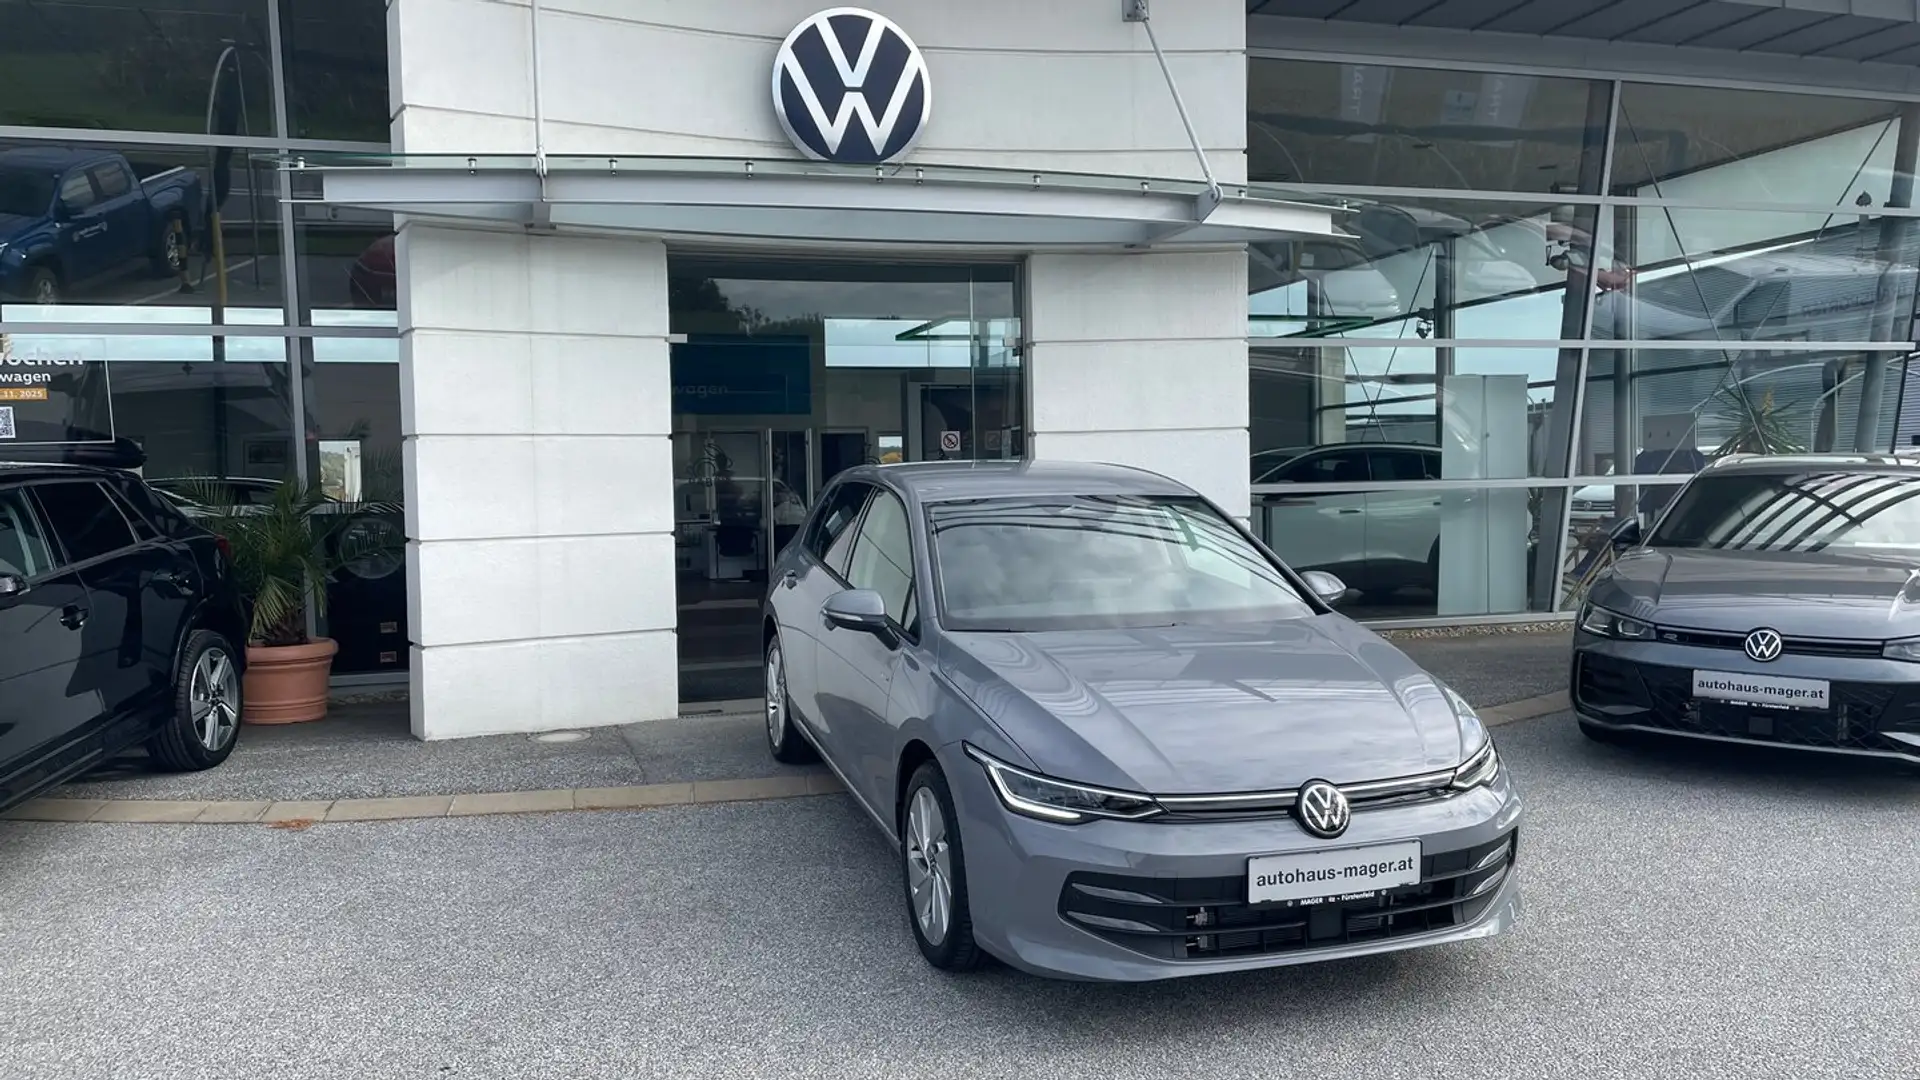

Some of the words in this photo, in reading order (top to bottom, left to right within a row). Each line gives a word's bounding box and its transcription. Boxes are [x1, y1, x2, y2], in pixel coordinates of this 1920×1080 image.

[0, 347, 84, 366] ochen
[1697, 679, 1824, 700] autohaus-mager.at
[1256, 856, 1414, 886] autohaus-mager.at
[1300, 897, 1324, 906] MAGER
